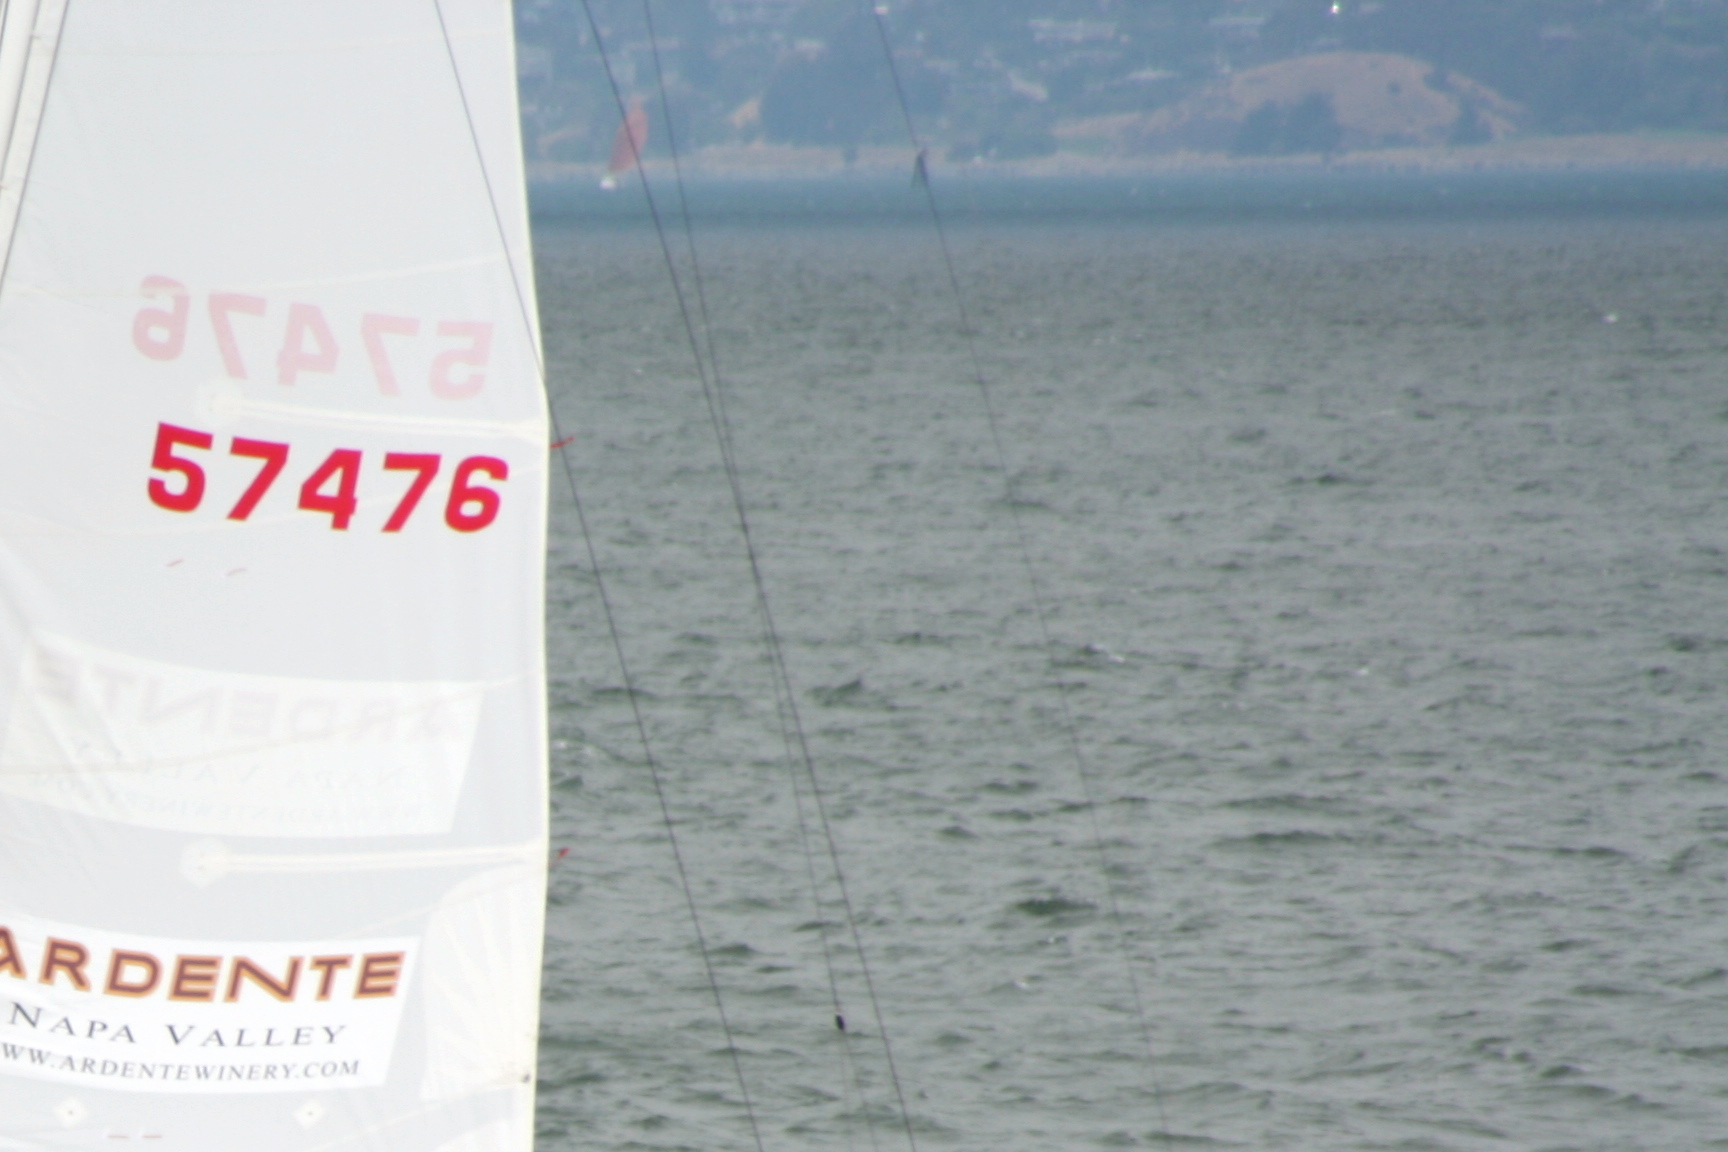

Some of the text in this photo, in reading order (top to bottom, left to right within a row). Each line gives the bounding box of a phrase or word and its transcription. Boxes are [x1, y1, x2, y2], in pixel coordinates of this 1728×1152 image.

[147, 421, 510, 533] 57476
[8, 1001, 346, 1047] NAPA VALLEY
